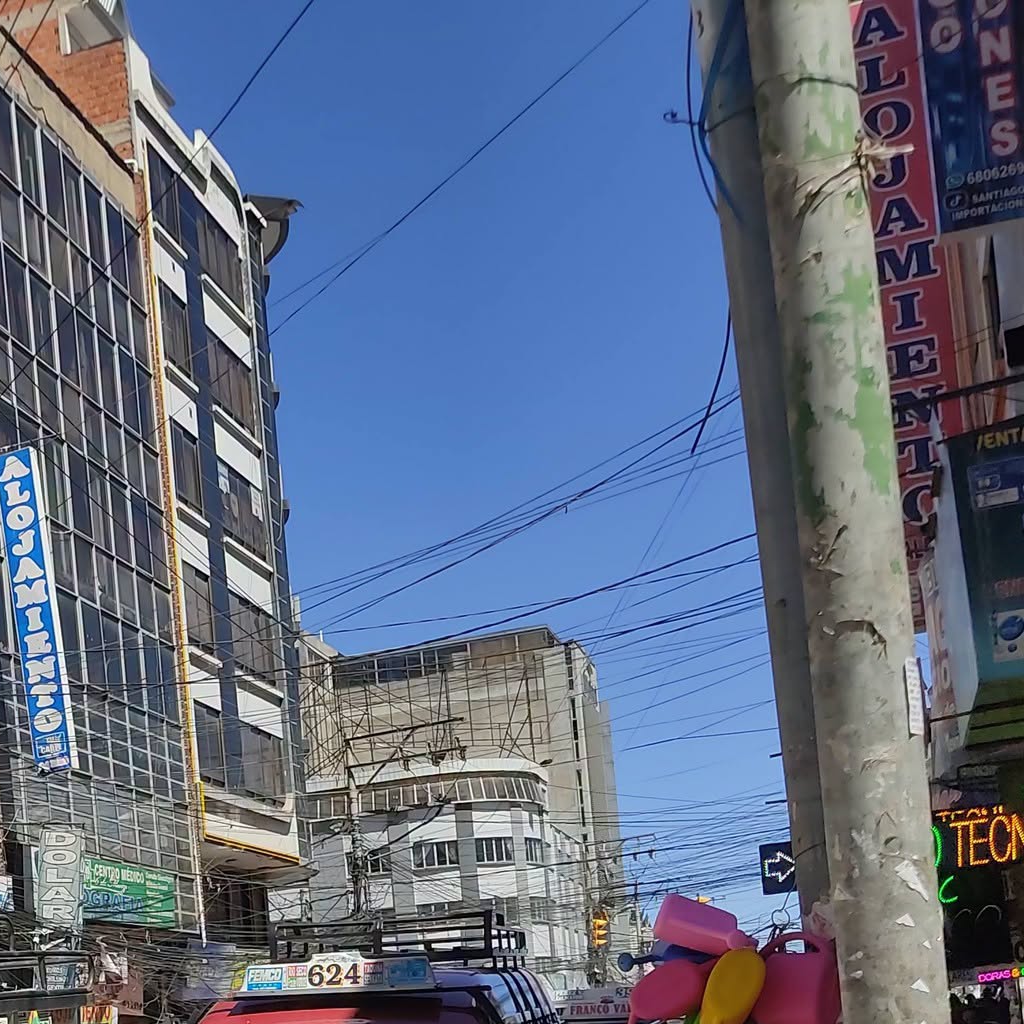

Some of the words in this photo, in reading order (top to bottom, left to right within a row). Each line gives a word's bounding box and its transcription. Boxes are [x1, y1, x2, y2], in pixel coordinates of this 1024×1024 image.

[39, 831, 77, 921] DOLAR
[307, 963, 361, 987] 624
[570, 1004, 610, 1015] FRANCO
